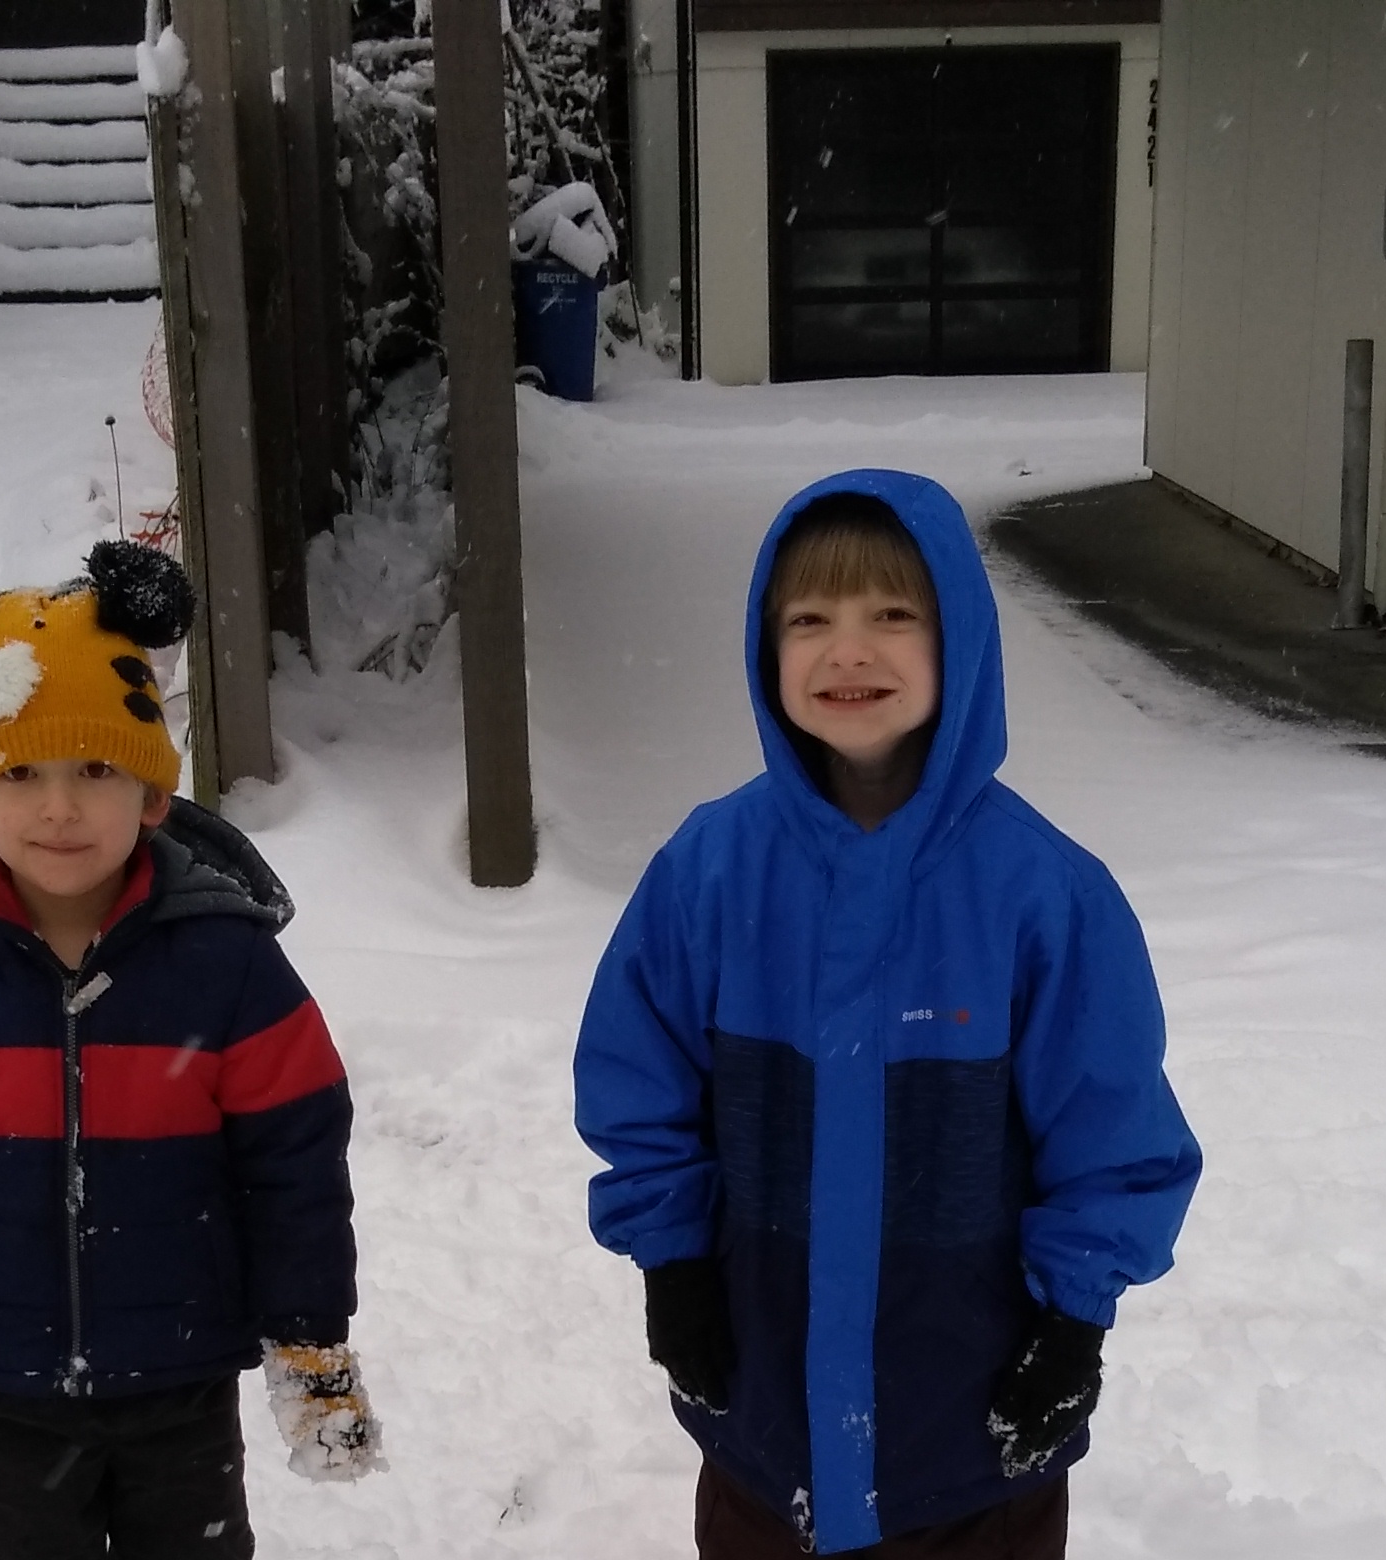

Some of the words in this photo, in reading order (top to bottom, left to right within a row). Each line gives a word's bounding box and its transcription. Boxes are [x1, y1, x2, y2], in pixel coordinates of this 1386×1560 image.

[1147, 79, 1158, 187] 2421
[536, 272, 579, 284] RECYCLE
[901, 1009, 934, 1022] SWISS
